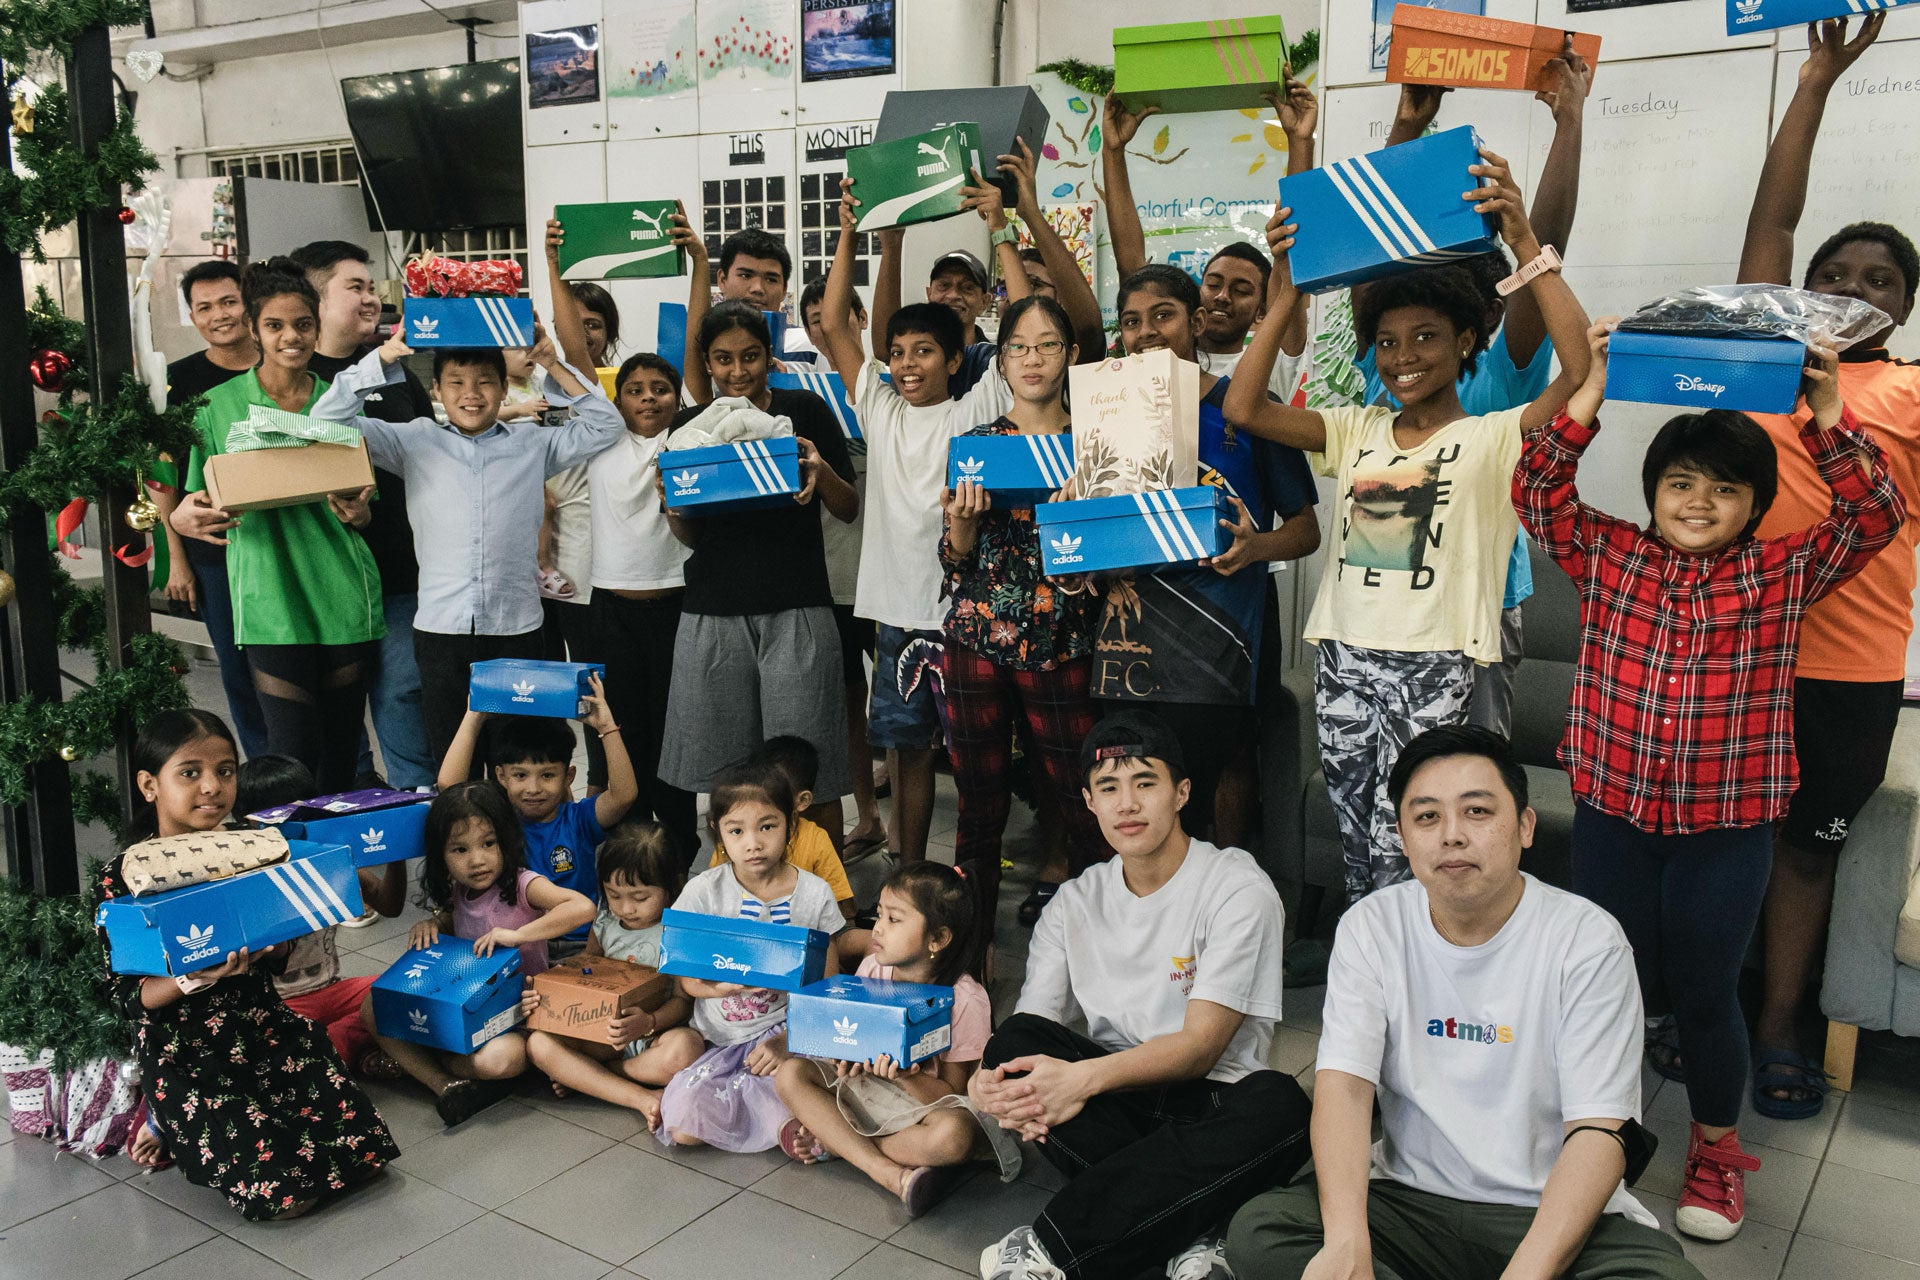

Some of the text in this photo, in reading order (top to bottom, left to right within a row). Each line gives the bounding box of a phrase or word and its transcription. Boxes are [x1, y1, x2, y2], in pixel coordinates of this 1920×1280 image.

[1736, 13, 1763, 24] adidas
[1428, 48, 1511, 82] SOMOS
[1844, 76, 1920, 97] Wednes
[1598, 91, 1680, 120] Tuesday
[729, 124, 873, 154] THIS MONTH
[917, 161, 945, 177] PUMA
[1136, 198, 1193, 218] olorful
[630, 230, 658, 241] PUMA
[1673, 373, 1726, 399] Disney
[1090, 386, 1127, 406] thank
[1099, 407, 1118, 423] you
[957, 474, 984, 482] adidas
[673, 487, 701, 496] adidas
[1052, 553, 1083, 565] adidas
[511, 695, 534, 703] adidas
[363, 844, 387, 853] adidas
[181, 945, 220, 964] adidas
[712, 953, 752, 976] Disney
[563, 1000, 613, 1026] Thanks
[409, 1024, 430, 1034] adidas
[1426, 1017, 1514, 1045] atmos
[832, 1036, 858, 1046] adidas
